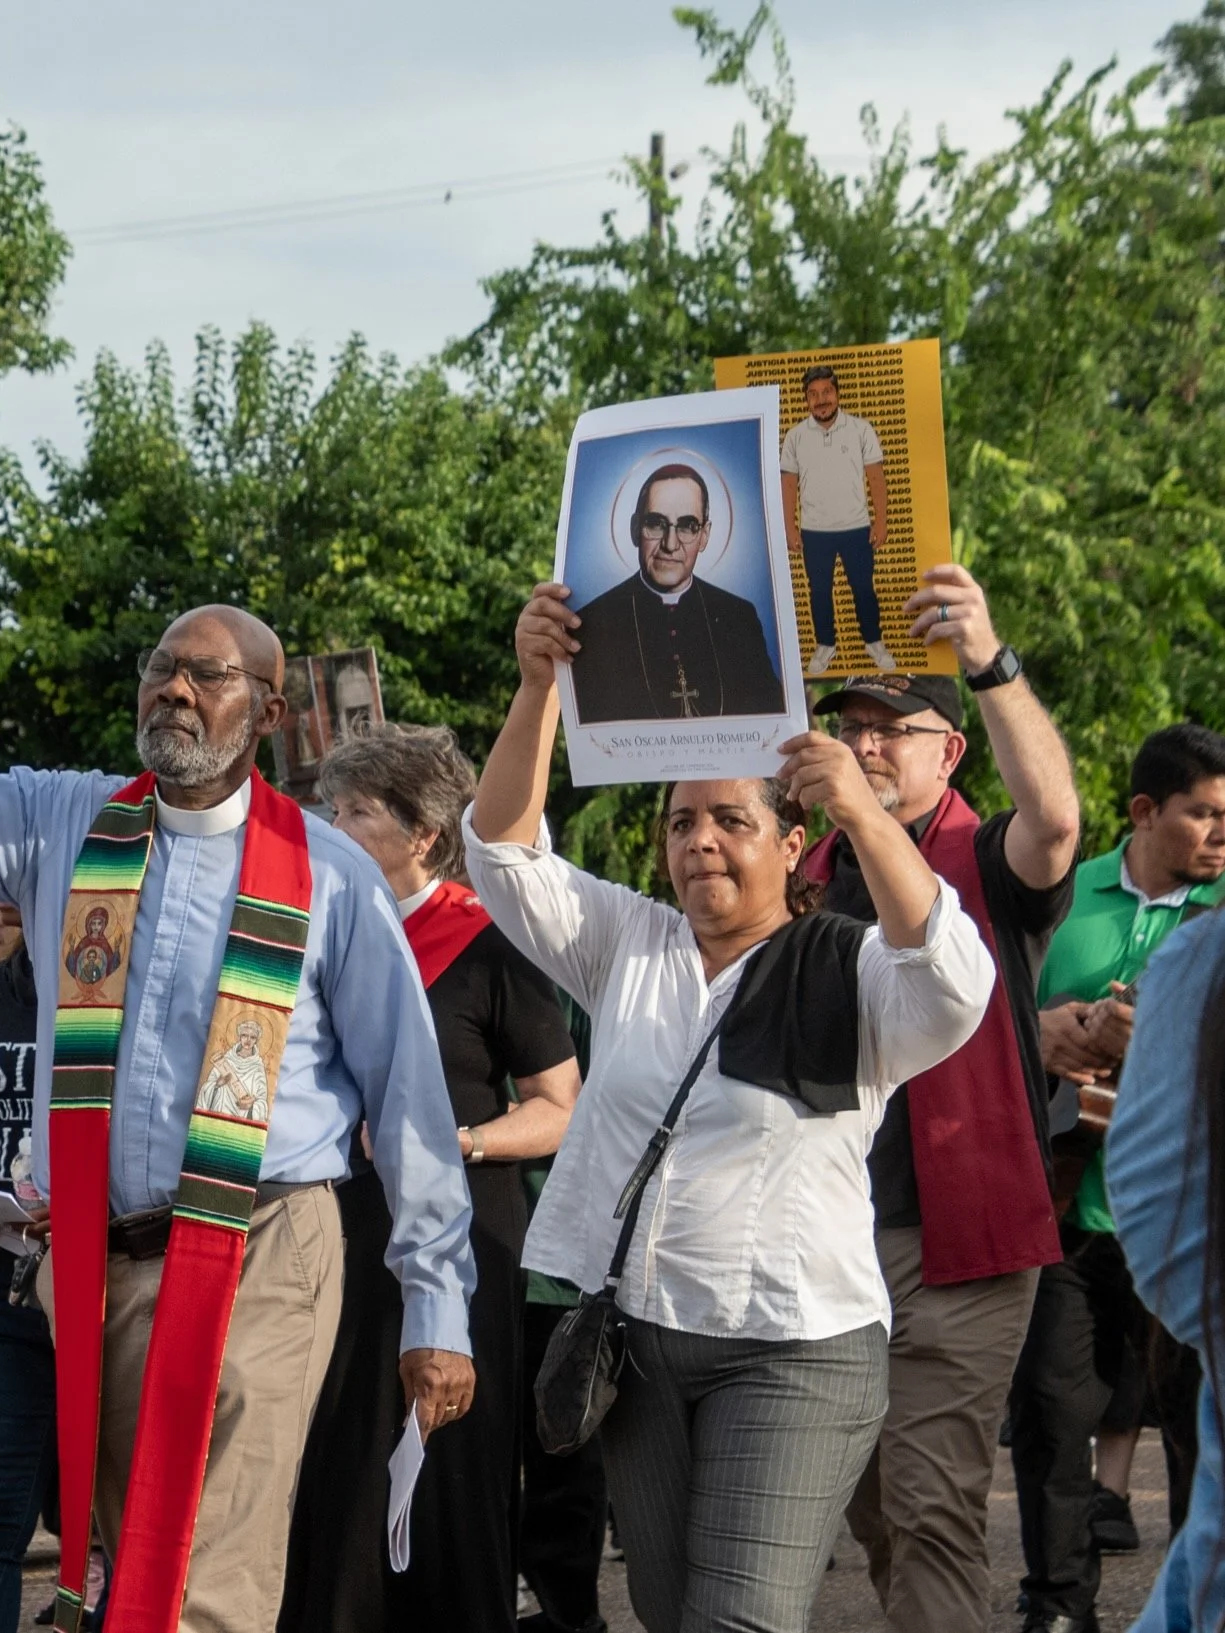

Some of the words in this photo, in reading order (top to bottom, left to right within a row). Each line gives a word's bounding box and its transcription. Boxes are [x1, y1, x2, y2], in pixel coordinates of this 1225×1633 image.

[787, 356, 811, 364] PARA
[813, 352, 855, 362] LORENZO
[856, 348, 902, 358] SALGADO
[857, 358, 902, 368] SALGADO
[858, 368, 903, 378] SALGADO
[858, 378, 903, 388] SALGADO
[859, 388, 904, 398] SALGADO
[860, 398, 904, 408] SALGADO
[861, 408, 905, 418] SALGADO
[882, 448, 908, 456] GADO
[874, 576, 917, 584] SALGADO
[876, 586, 918, 594] SALGADO
[670, 733, 714, 745] ARNULFO
[717, 731, 760, 744] ROMERO
